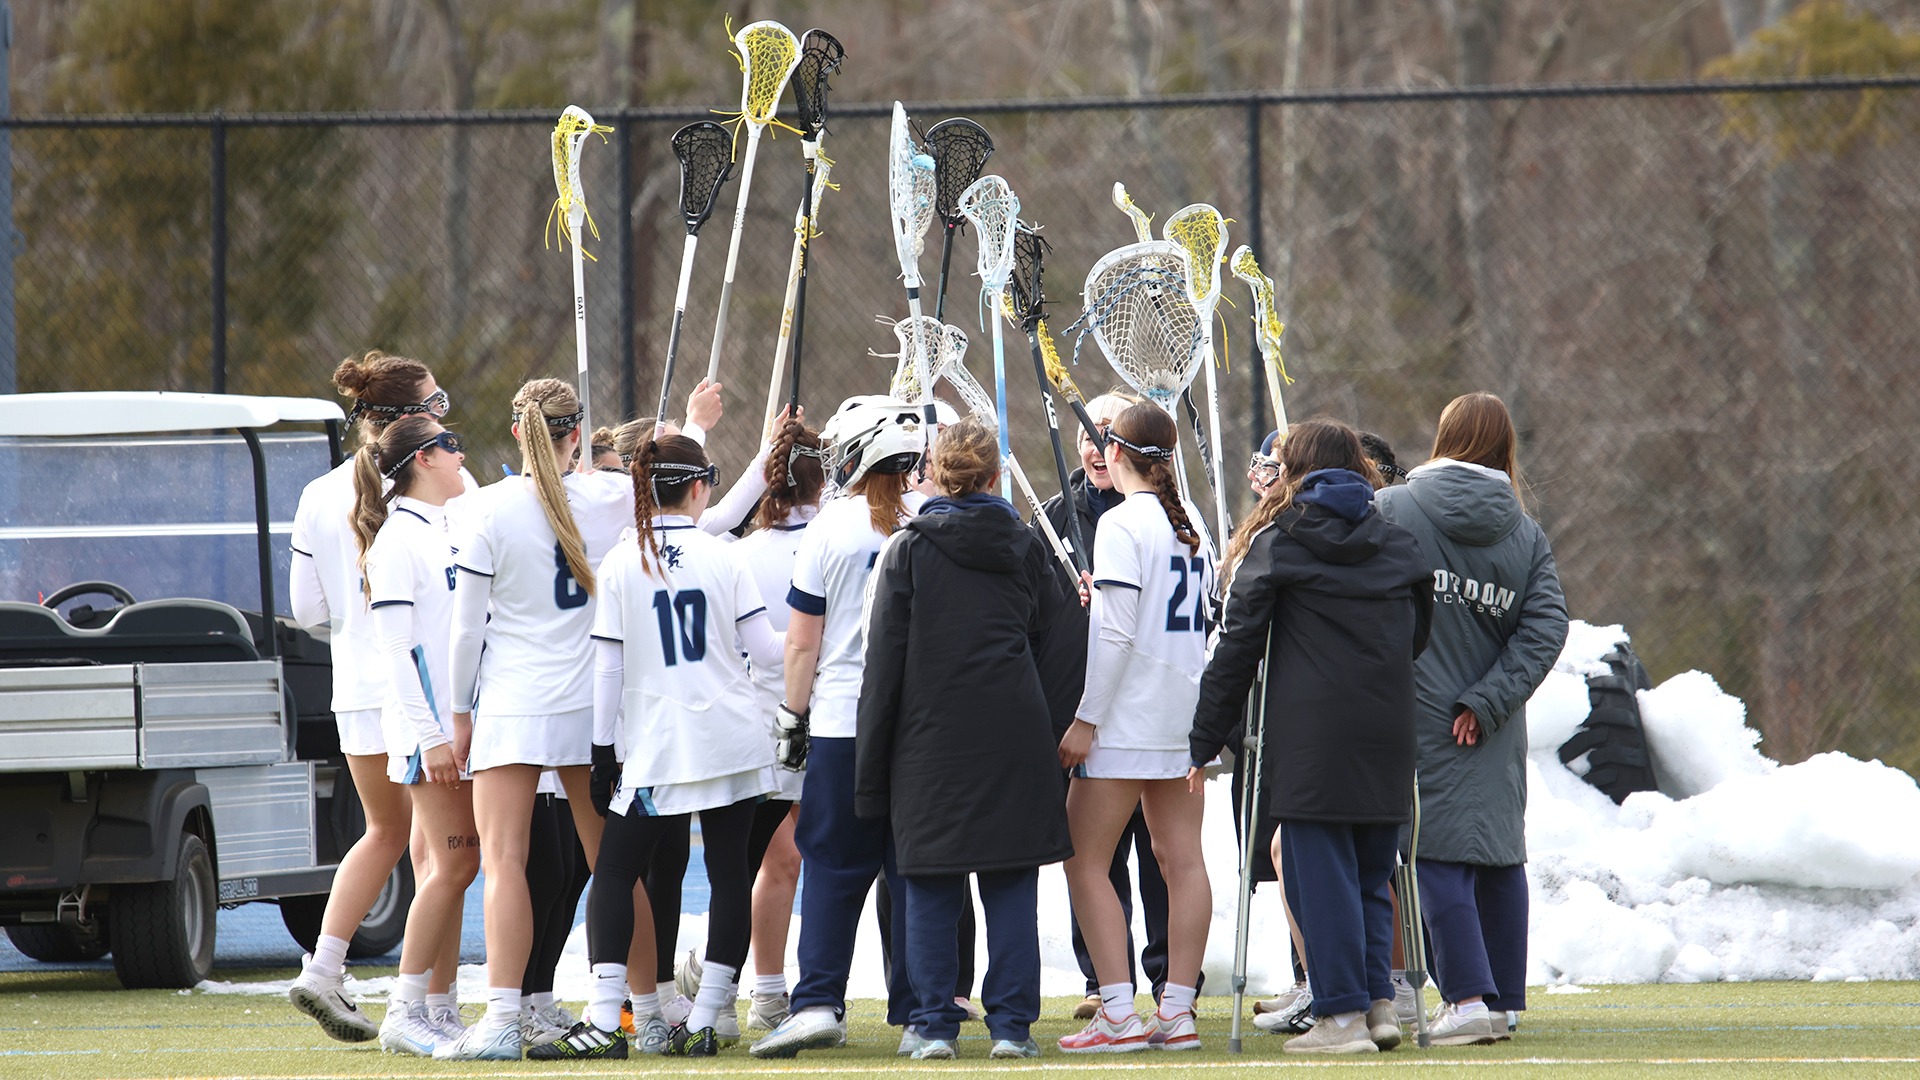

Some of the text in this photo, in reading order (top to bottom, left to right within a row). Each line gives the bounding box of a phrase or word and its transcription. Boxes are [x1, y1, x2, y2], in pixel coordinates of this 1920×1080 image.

[373, 405, 428, 413] STX STX
[1042, 390, 1059, 430] STX
[344, 411, 358, 431] STX
[400, 449, 418, 466] UNDER
[1026, 495, 1042, 517] GAIT
[1433, 569, 1516, 611] ORDON
[652, 588, 708, 667] 10
[447, 836, 464, 850] FOR
[244, 878, 258, 896] 700
